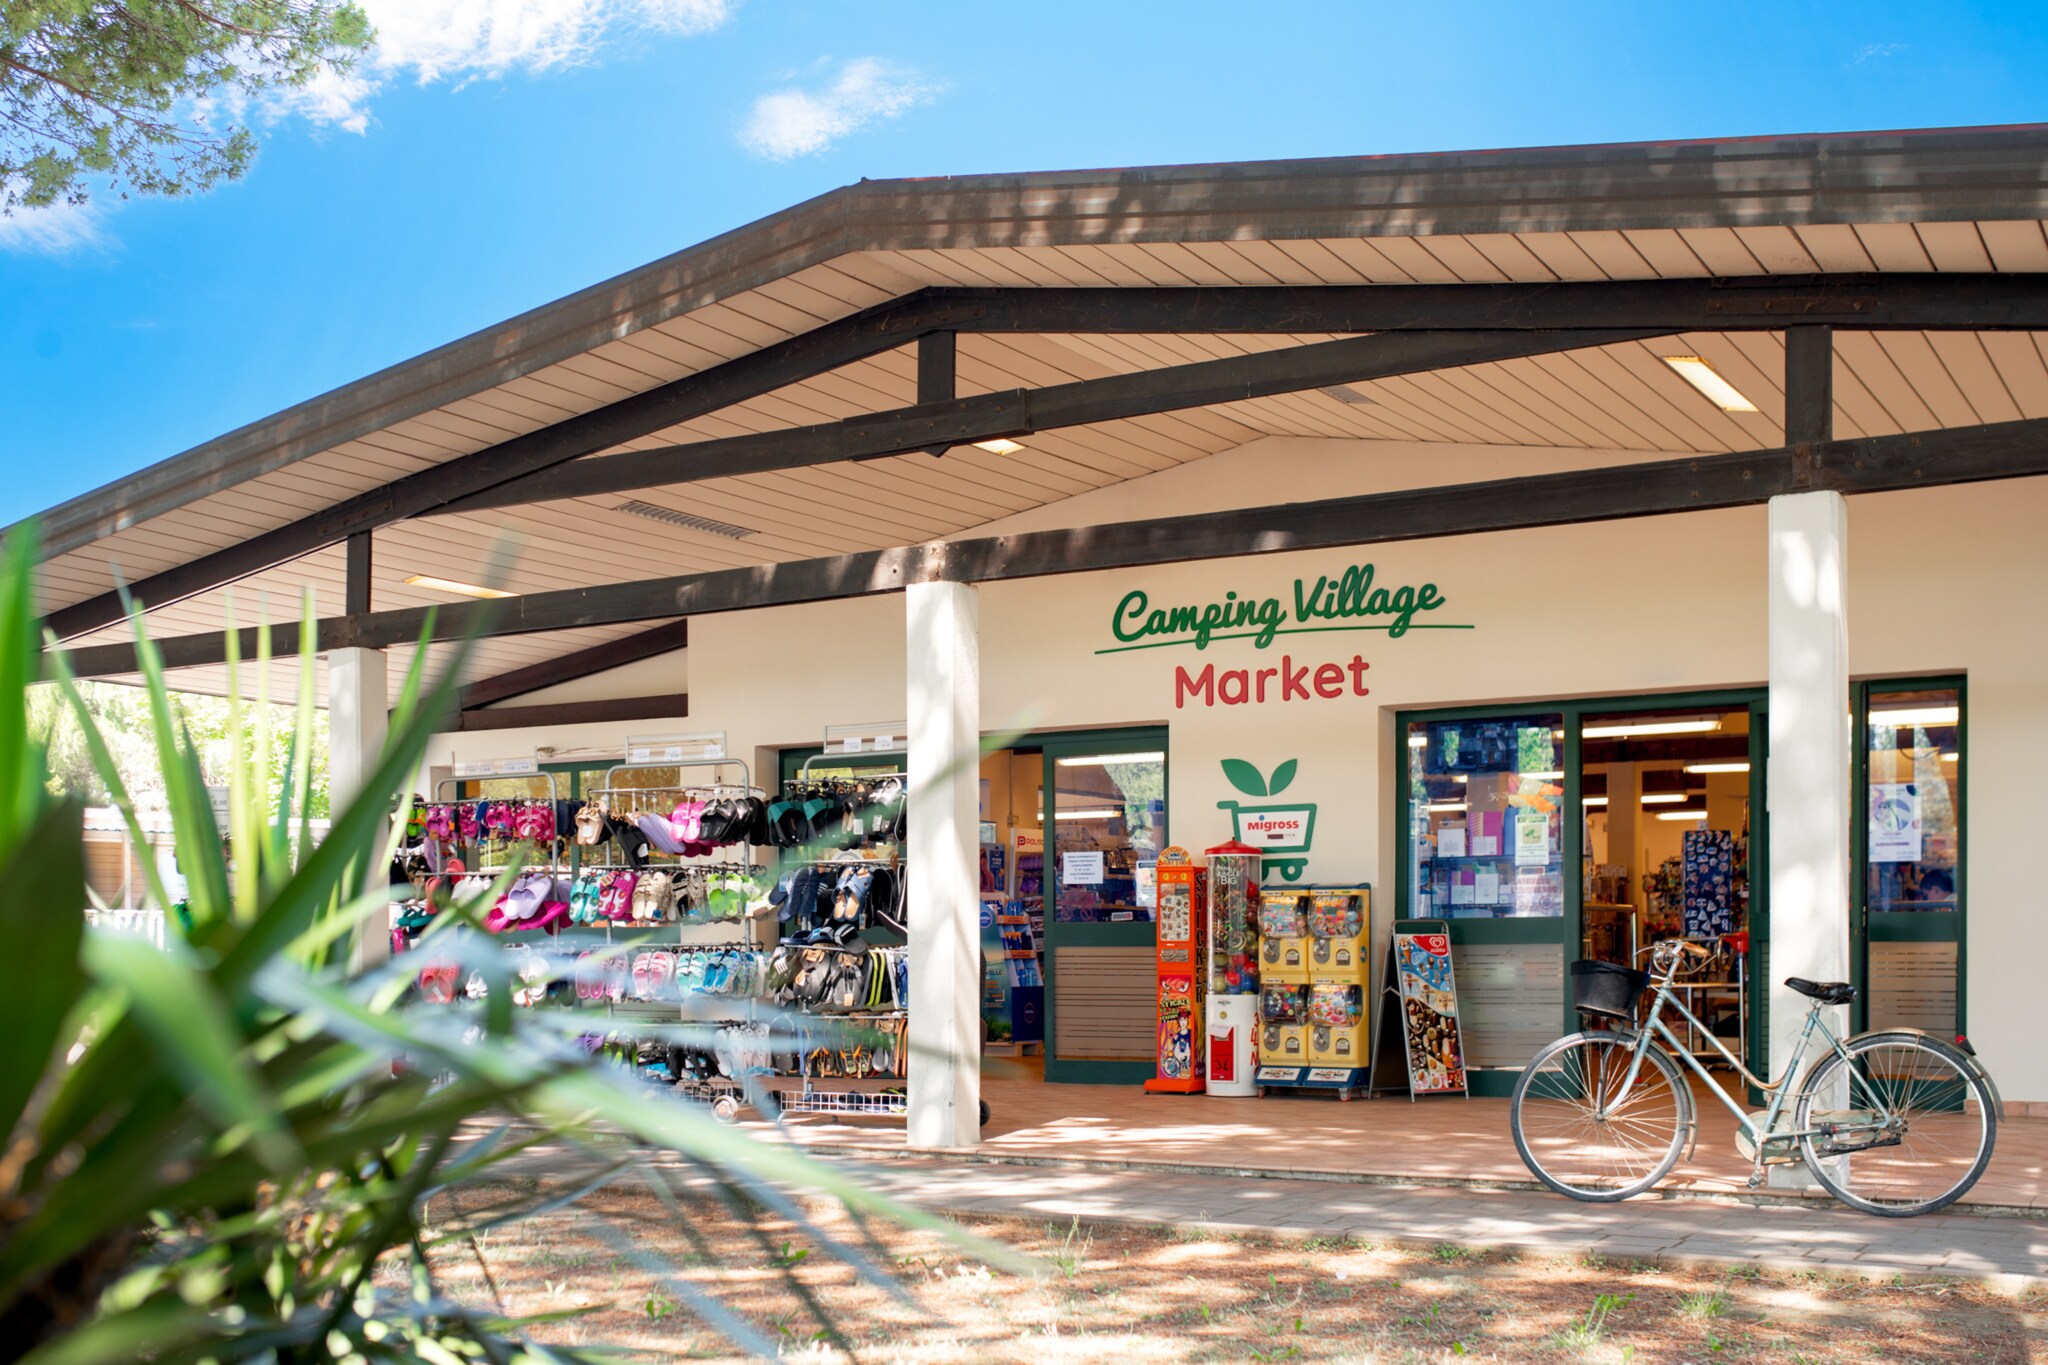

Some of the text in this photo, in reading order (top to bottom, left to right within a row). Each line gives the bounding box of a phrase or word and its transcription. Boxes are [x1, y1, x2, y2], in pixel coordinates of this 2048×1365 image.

[1112, 563, 1446, 650] Camping Village
[1175, 655, 1370, 709] Market
[1247, 815, 1300, 832] Migross
[1220, 876, 1238, 885] BIG
